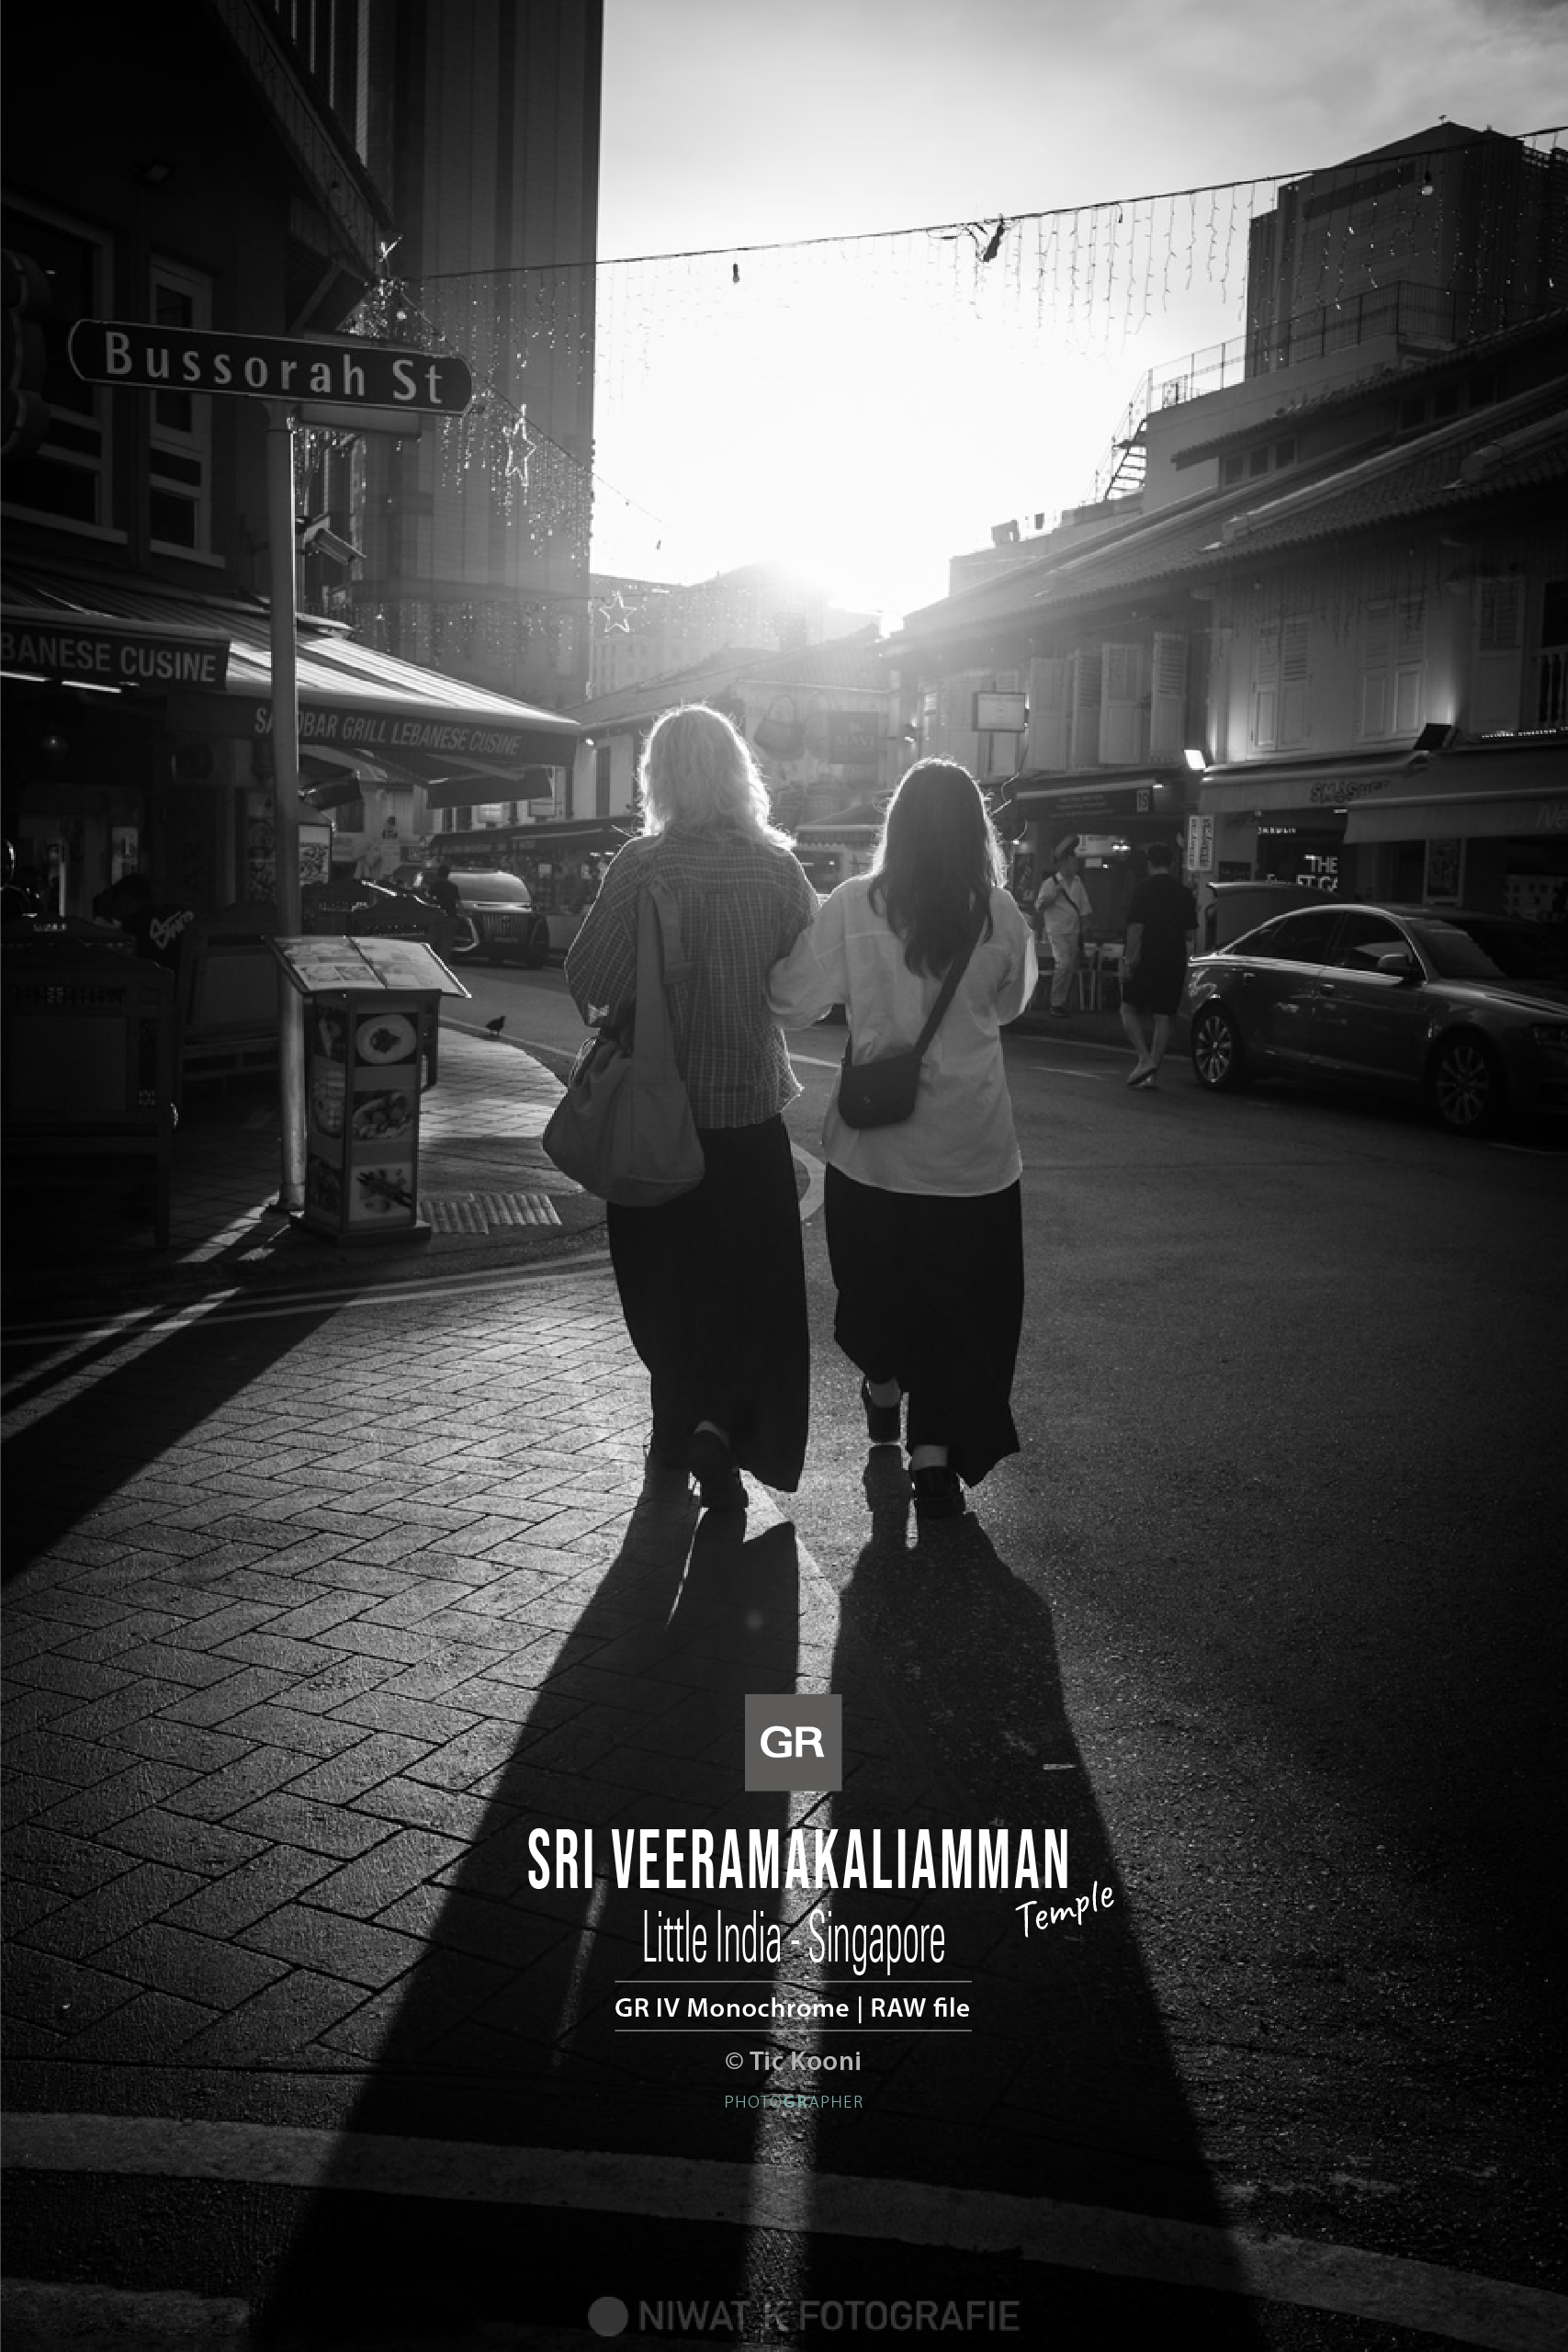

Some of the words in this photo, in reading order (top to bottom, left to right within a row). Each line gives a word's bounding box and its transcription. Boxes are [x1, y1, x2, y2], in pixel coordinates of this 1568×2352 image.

[105, 331, 366, 396] Bussorah
[392, 359, 443, 404] St
[1, 631, 112, 673] BANESE
[119, 645, 217, 683] CUSINE
[254, 707, 338, 739] SBAR
[342, 716, 386, 743] GRILL
[390, 722, 470, 751] LEBANESE
[469, 729, 522, 755] CUSINE
[1303, 854, 1338, 874] THE
